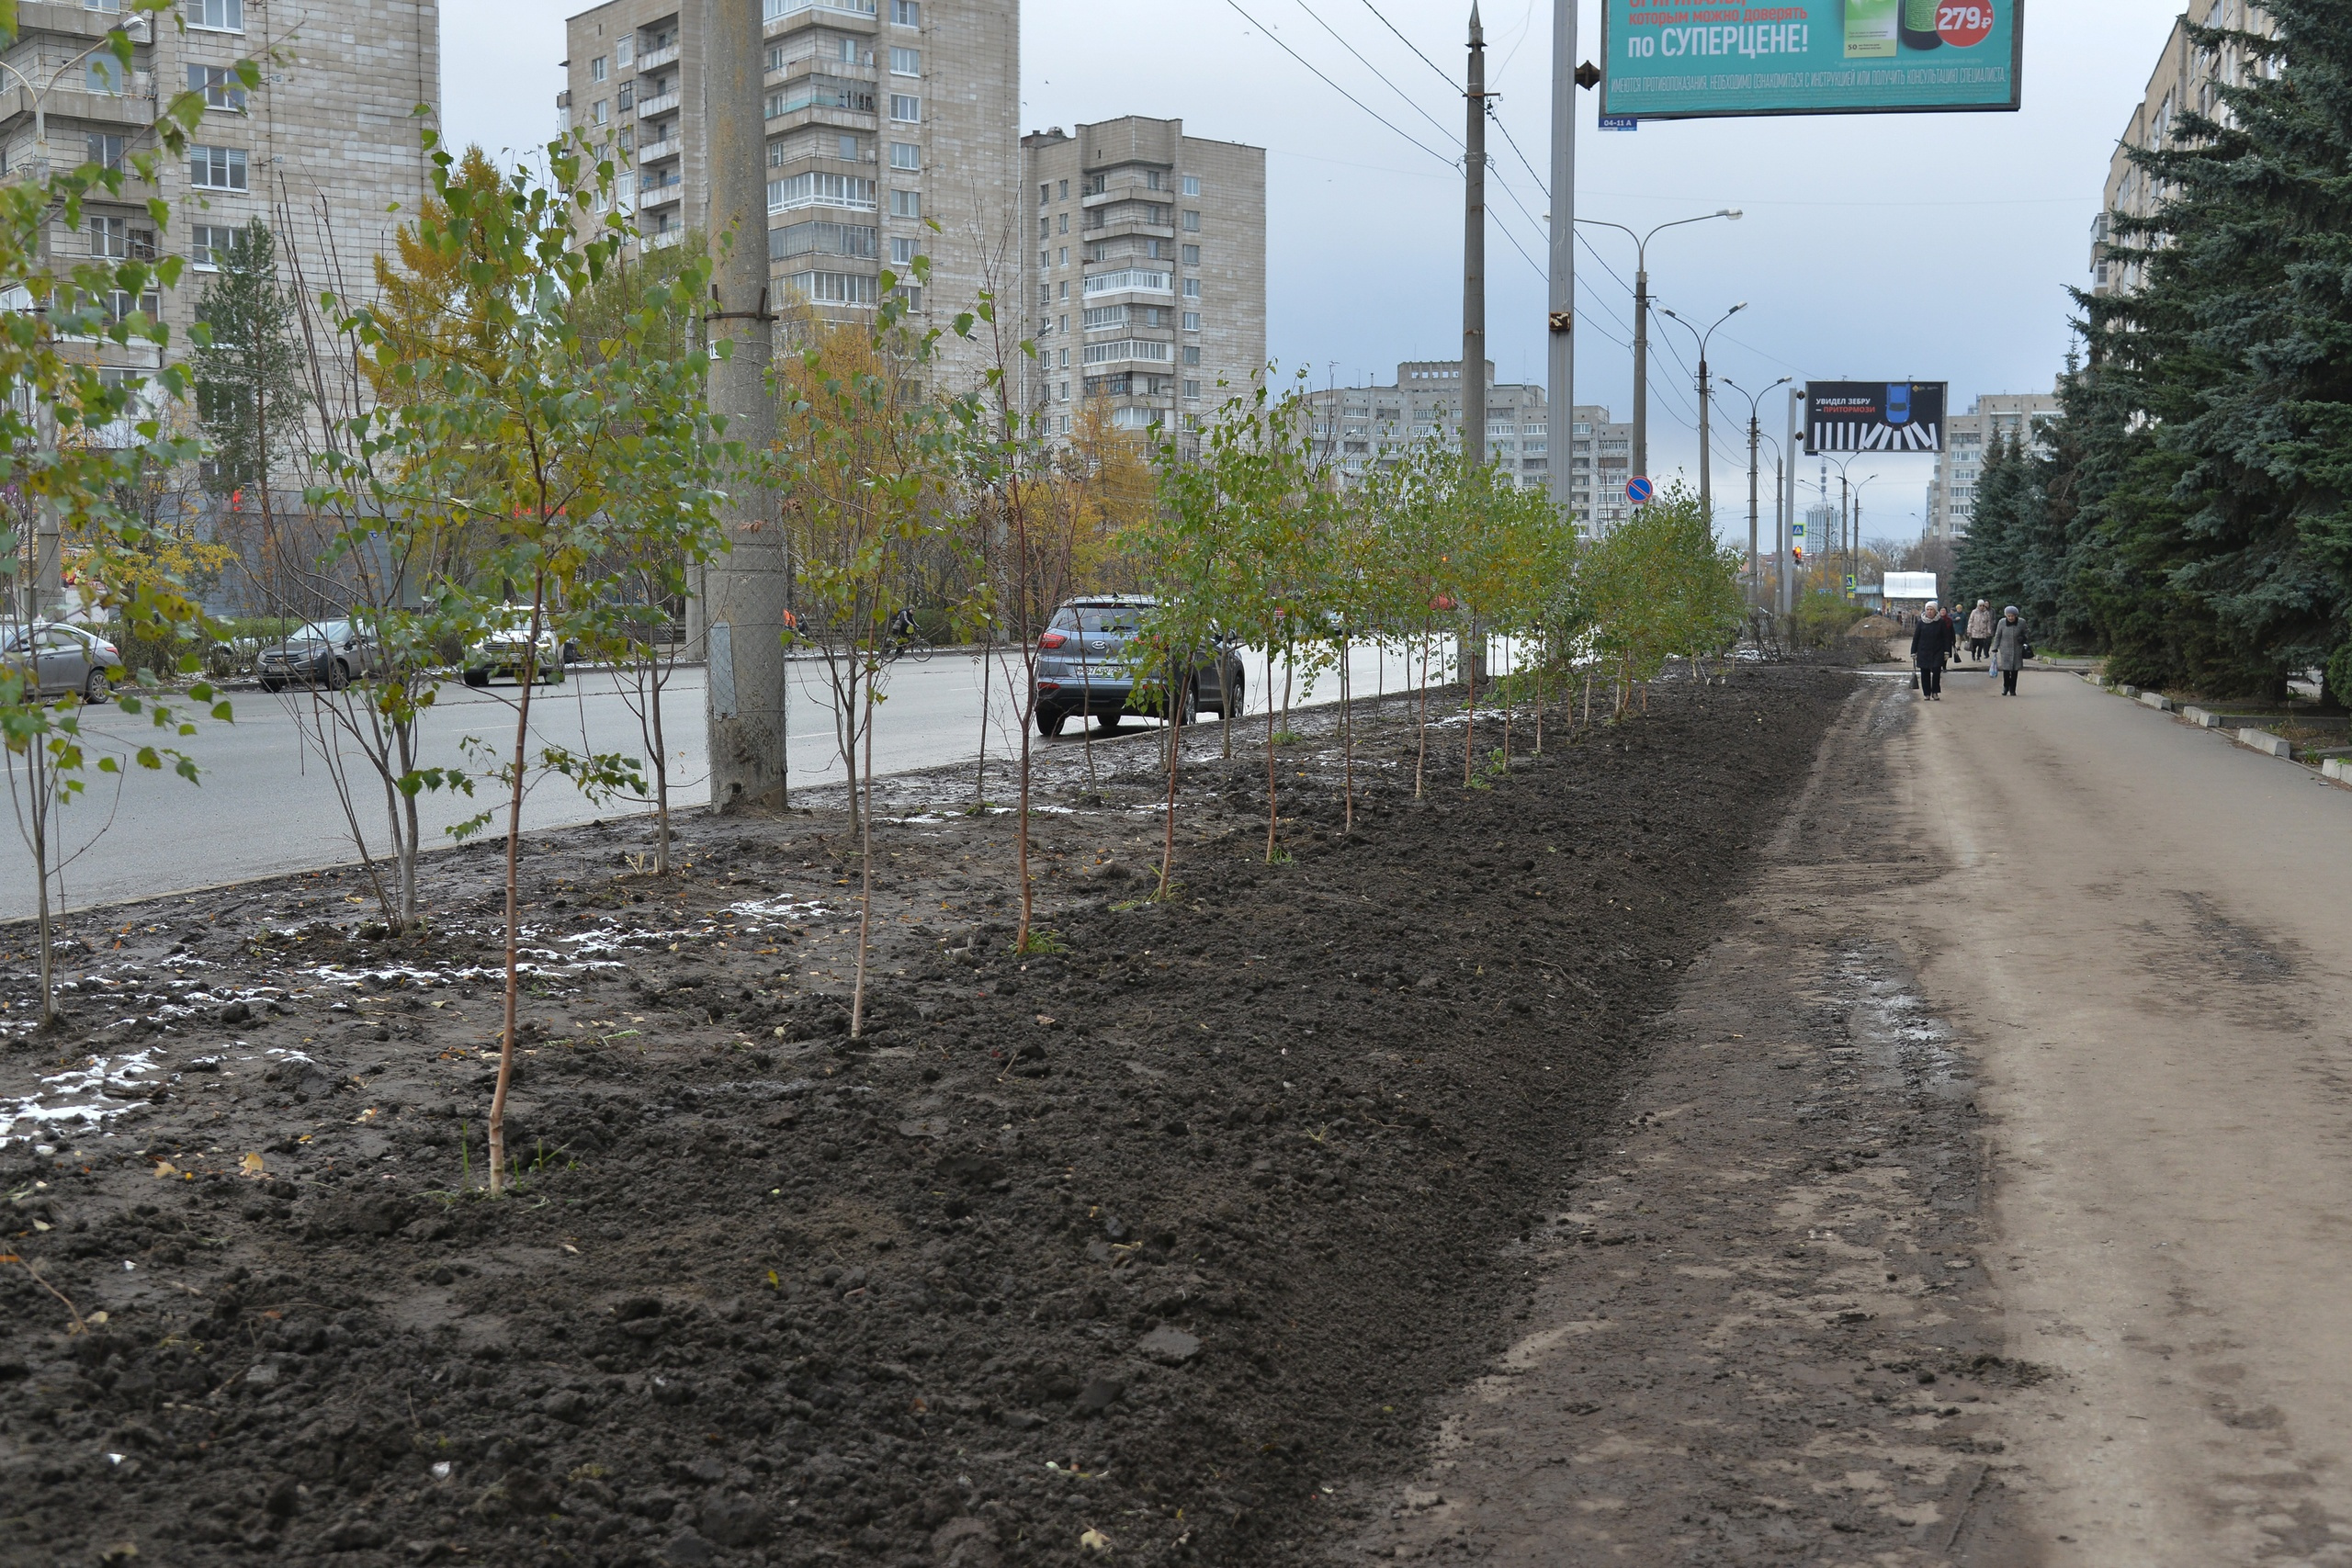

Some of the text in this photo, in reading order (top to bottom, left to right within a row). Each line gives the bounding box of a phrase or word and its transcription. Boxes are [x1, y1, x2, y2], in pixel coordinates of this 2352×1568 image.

[1629, 7, 1808, 28] которым можно доверять
[1628, 24, 1808, 59] по СУПЕРЦЕНЕ!
[1611, 77, 1641, 93] ИМЕЮТСЯ
[1710, 73, 1751, 90] НЕОБХОДИМО
[1753, 72, 1803, 88] ОЗНАКОМИТЬСЯ
[1804, 72, 1810, 87] С
[1811, 69, 1855, 87] ИНСТРУКЦИЕЙ
[1857, 70, 1871, 85] ИЛИ
[1871, 69, 1905, 85] ПОЛУЧИТЬ
[1907, 67, 1958, 85] КОНСУЛЬТАЦИЮ
